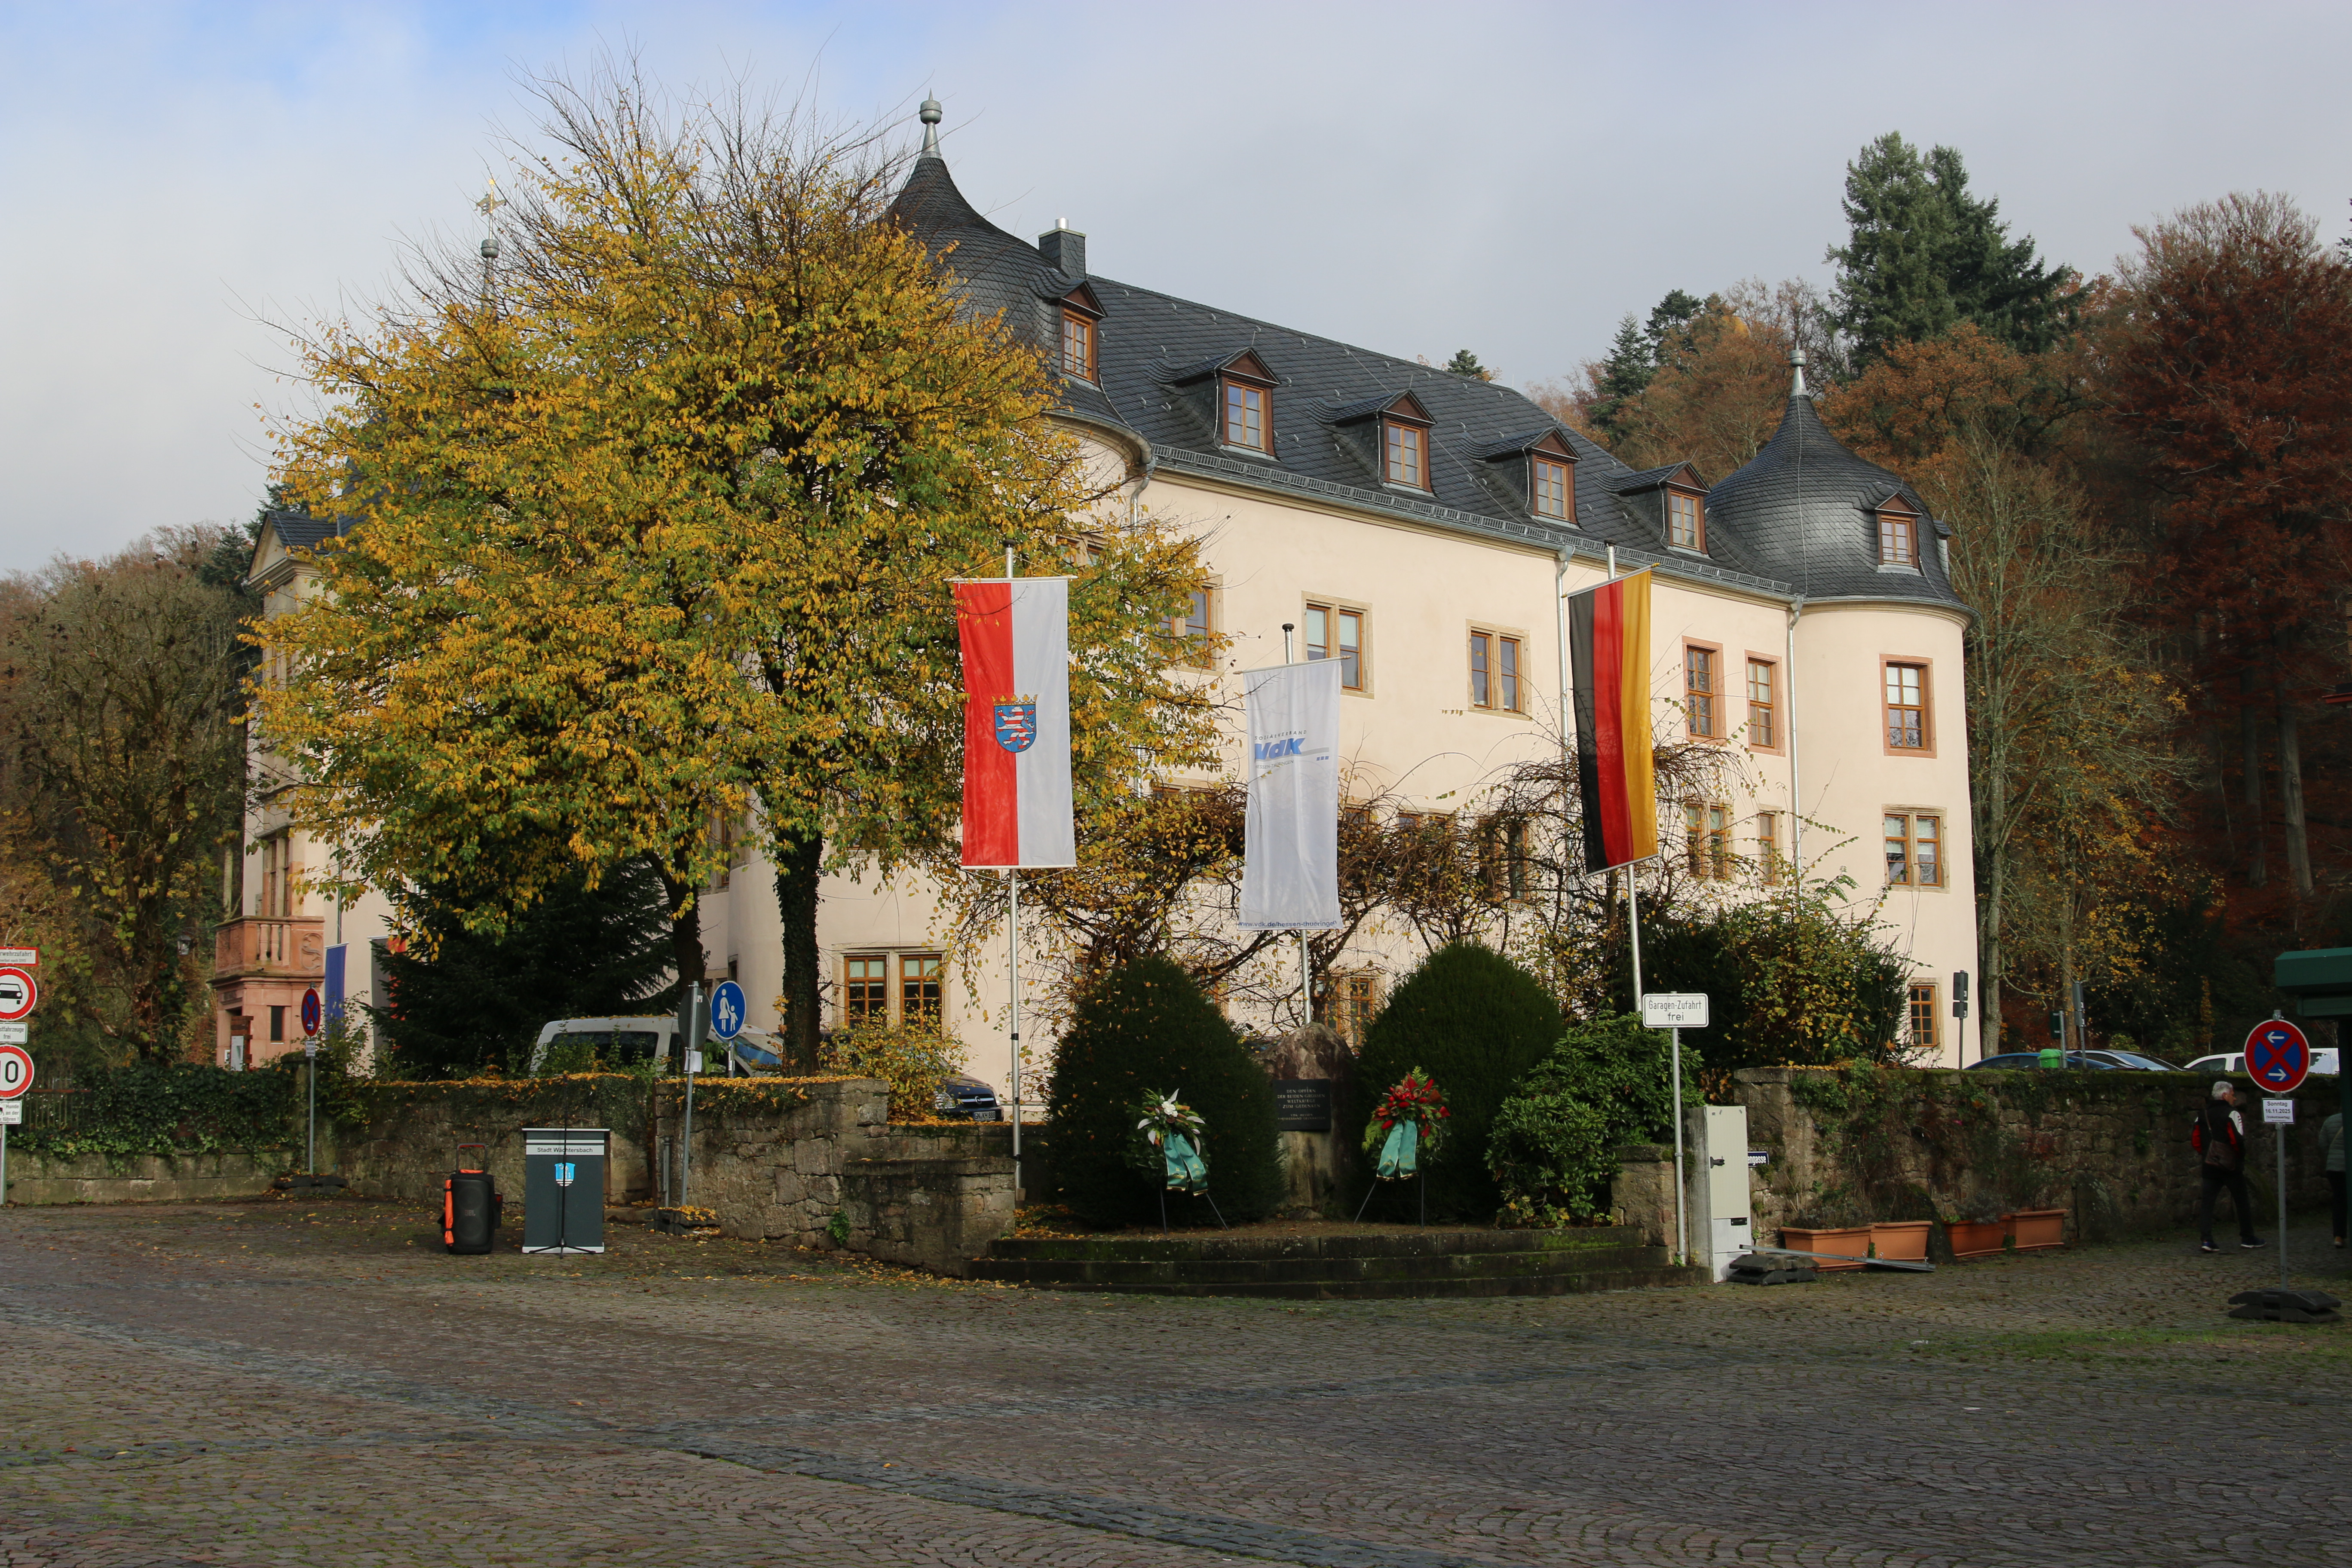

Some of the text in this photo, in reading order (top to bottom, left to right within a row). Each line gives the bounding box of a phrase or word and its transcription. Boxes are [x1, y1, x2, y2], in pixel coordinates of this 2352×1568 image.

[1254, 730, 1307, 740] SOZIALVERBAND
[1255, 738, 1306, 760] VdK
[1649, 1000, 1702, 1012] Garagen-Zufahrt
[1668, 1012, 1684, 1021] frei
